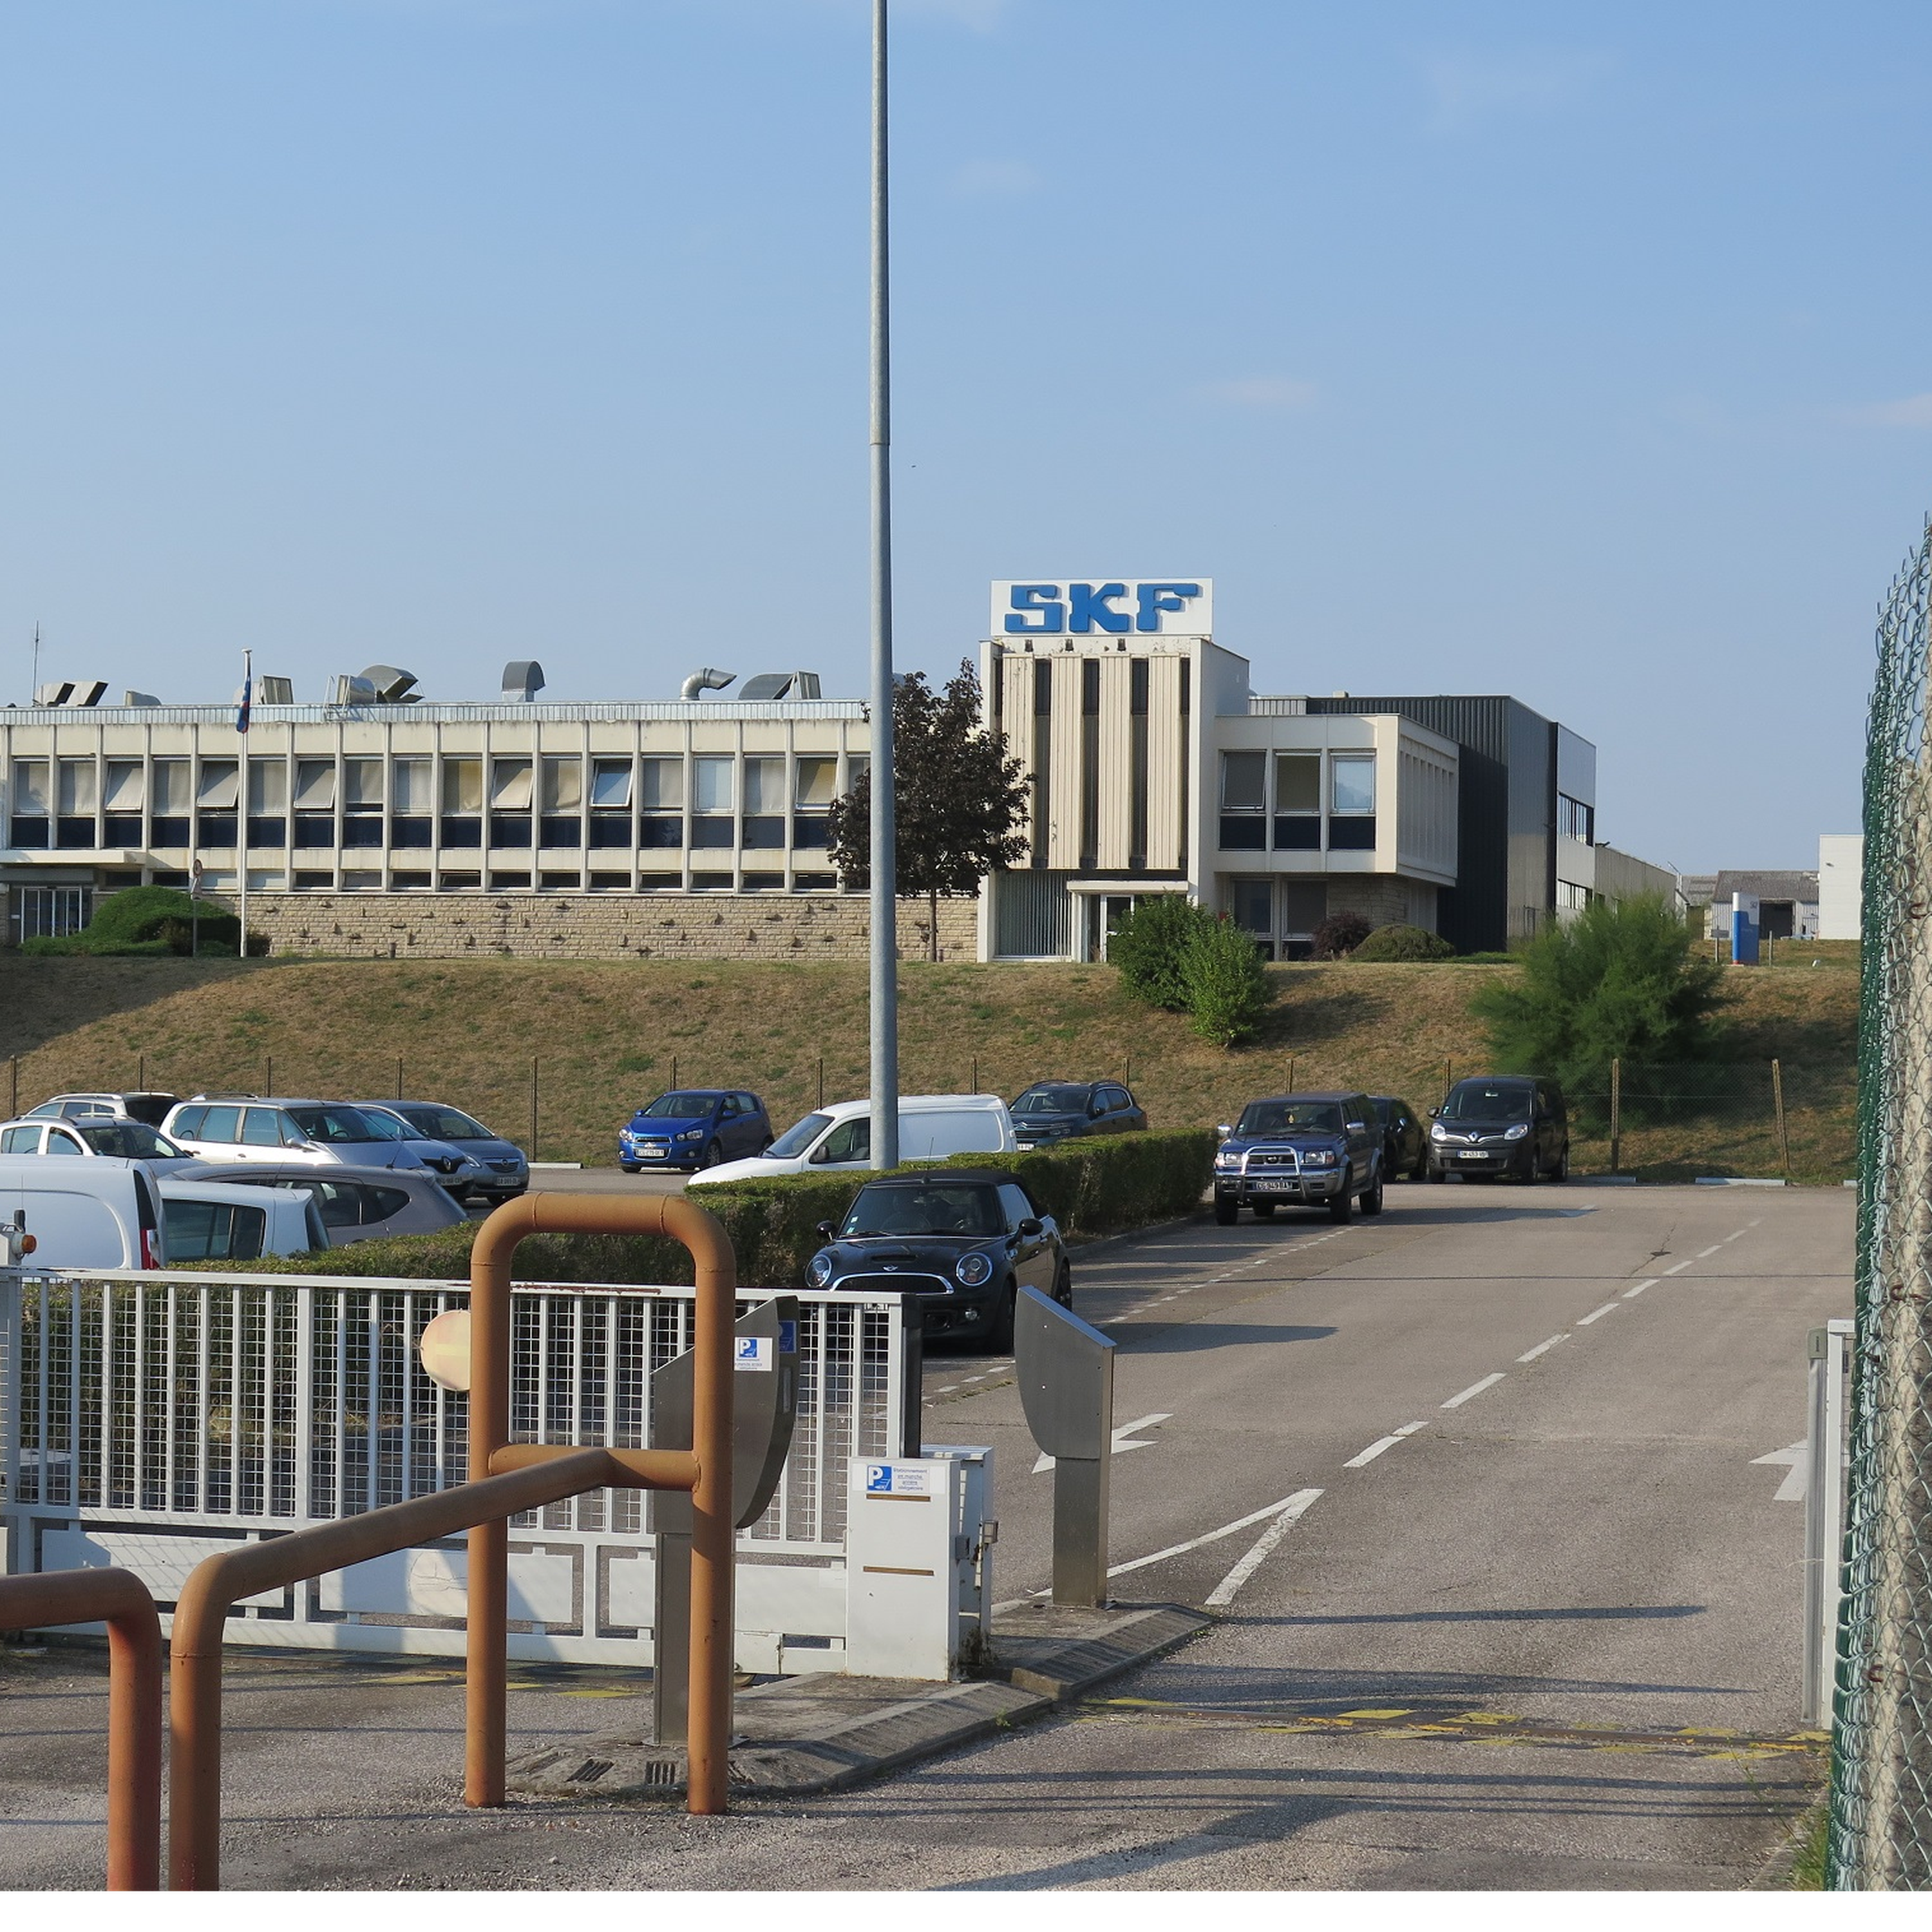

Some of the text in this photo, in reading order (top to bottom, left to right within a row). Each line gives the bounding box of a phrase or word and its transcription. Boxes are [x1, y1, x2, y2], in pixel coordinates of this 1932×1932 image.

[1004, 583, 1199, 632] SKF
[740, 1340, 752, 1354] P
[868, 1466, 883, 1486] P
